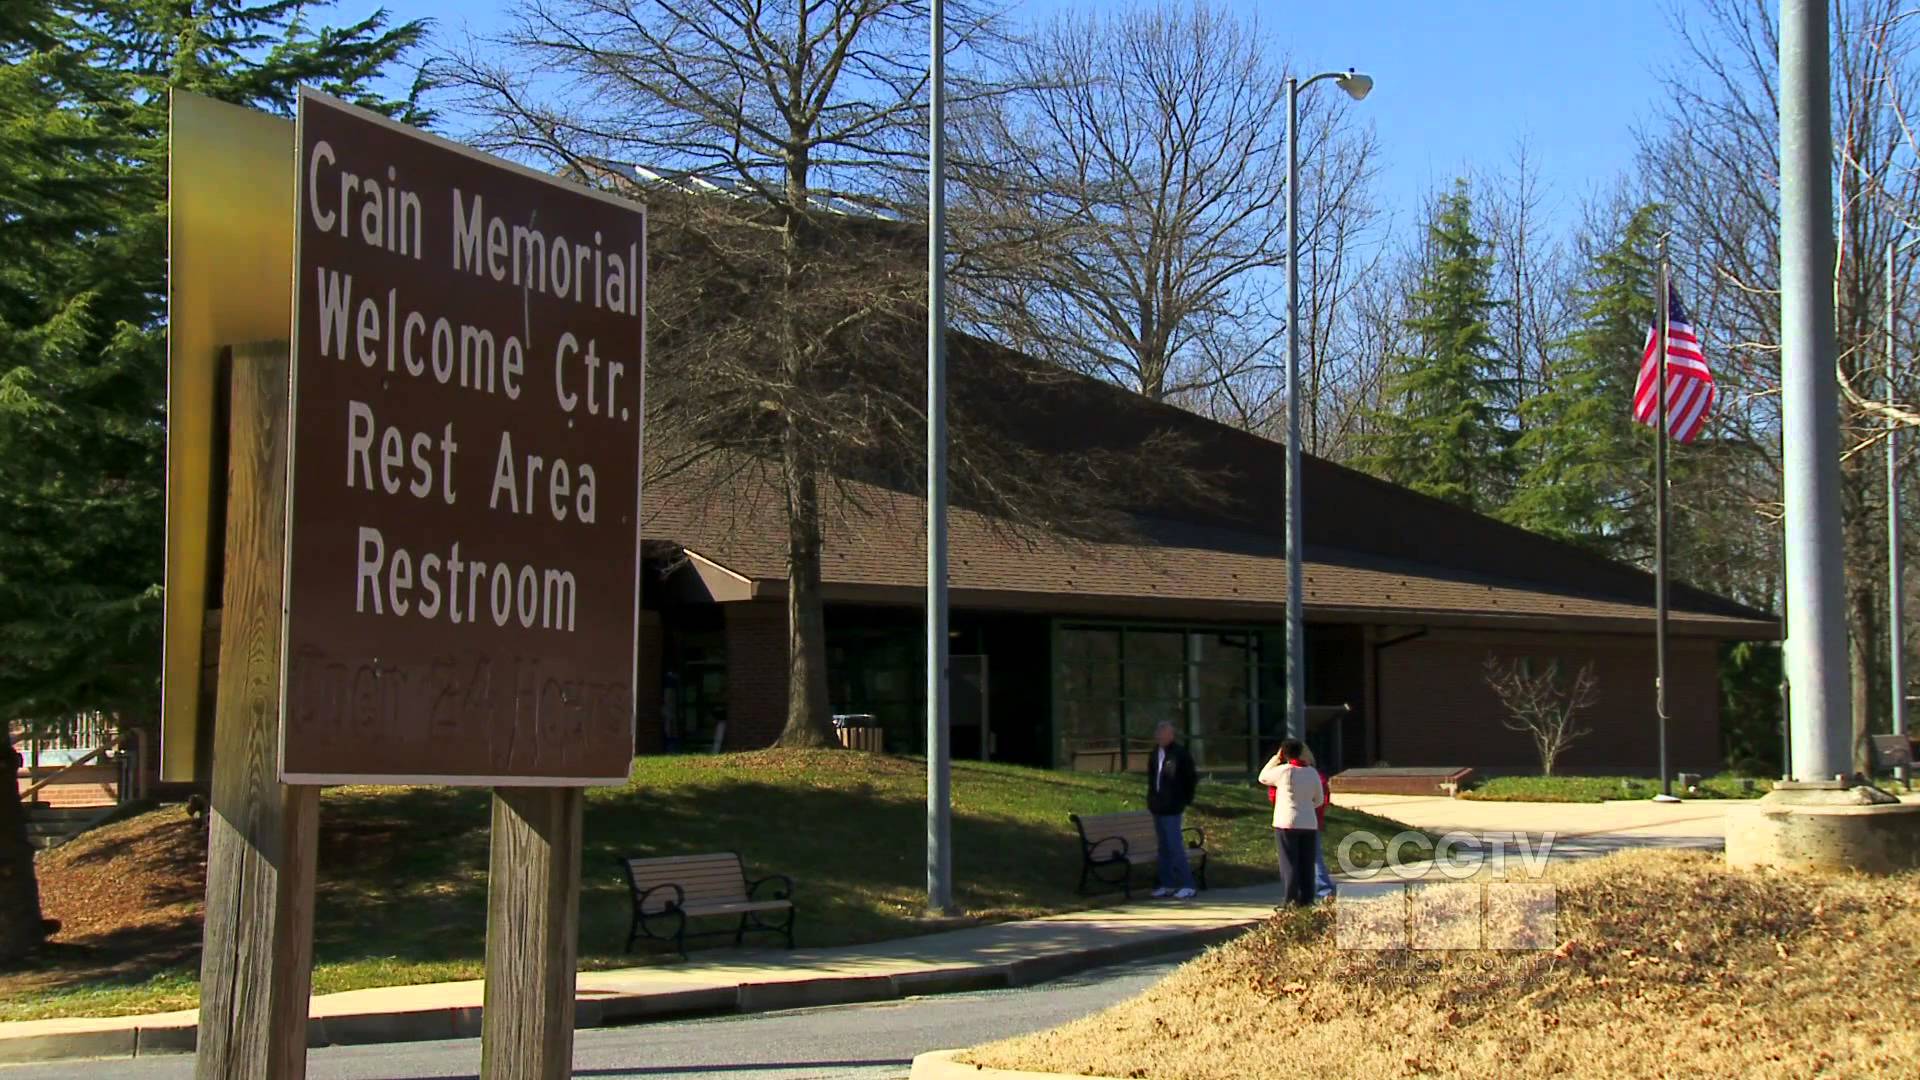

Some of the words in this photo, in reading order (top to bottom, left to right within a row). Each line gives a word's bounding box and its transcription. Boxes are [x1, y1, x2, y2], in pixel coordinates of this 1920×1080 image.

[309, 140, 422, 261] Crain
[453, 188, 637, 317] Memorial
[317, 266, 524, 400] Welcome
[555, 332, 629, 421] Ctr.
[346, 400, 458, 505] Rest
[489, 431, 596, 524] Area
[356, 526, 577, 632] Restroom
